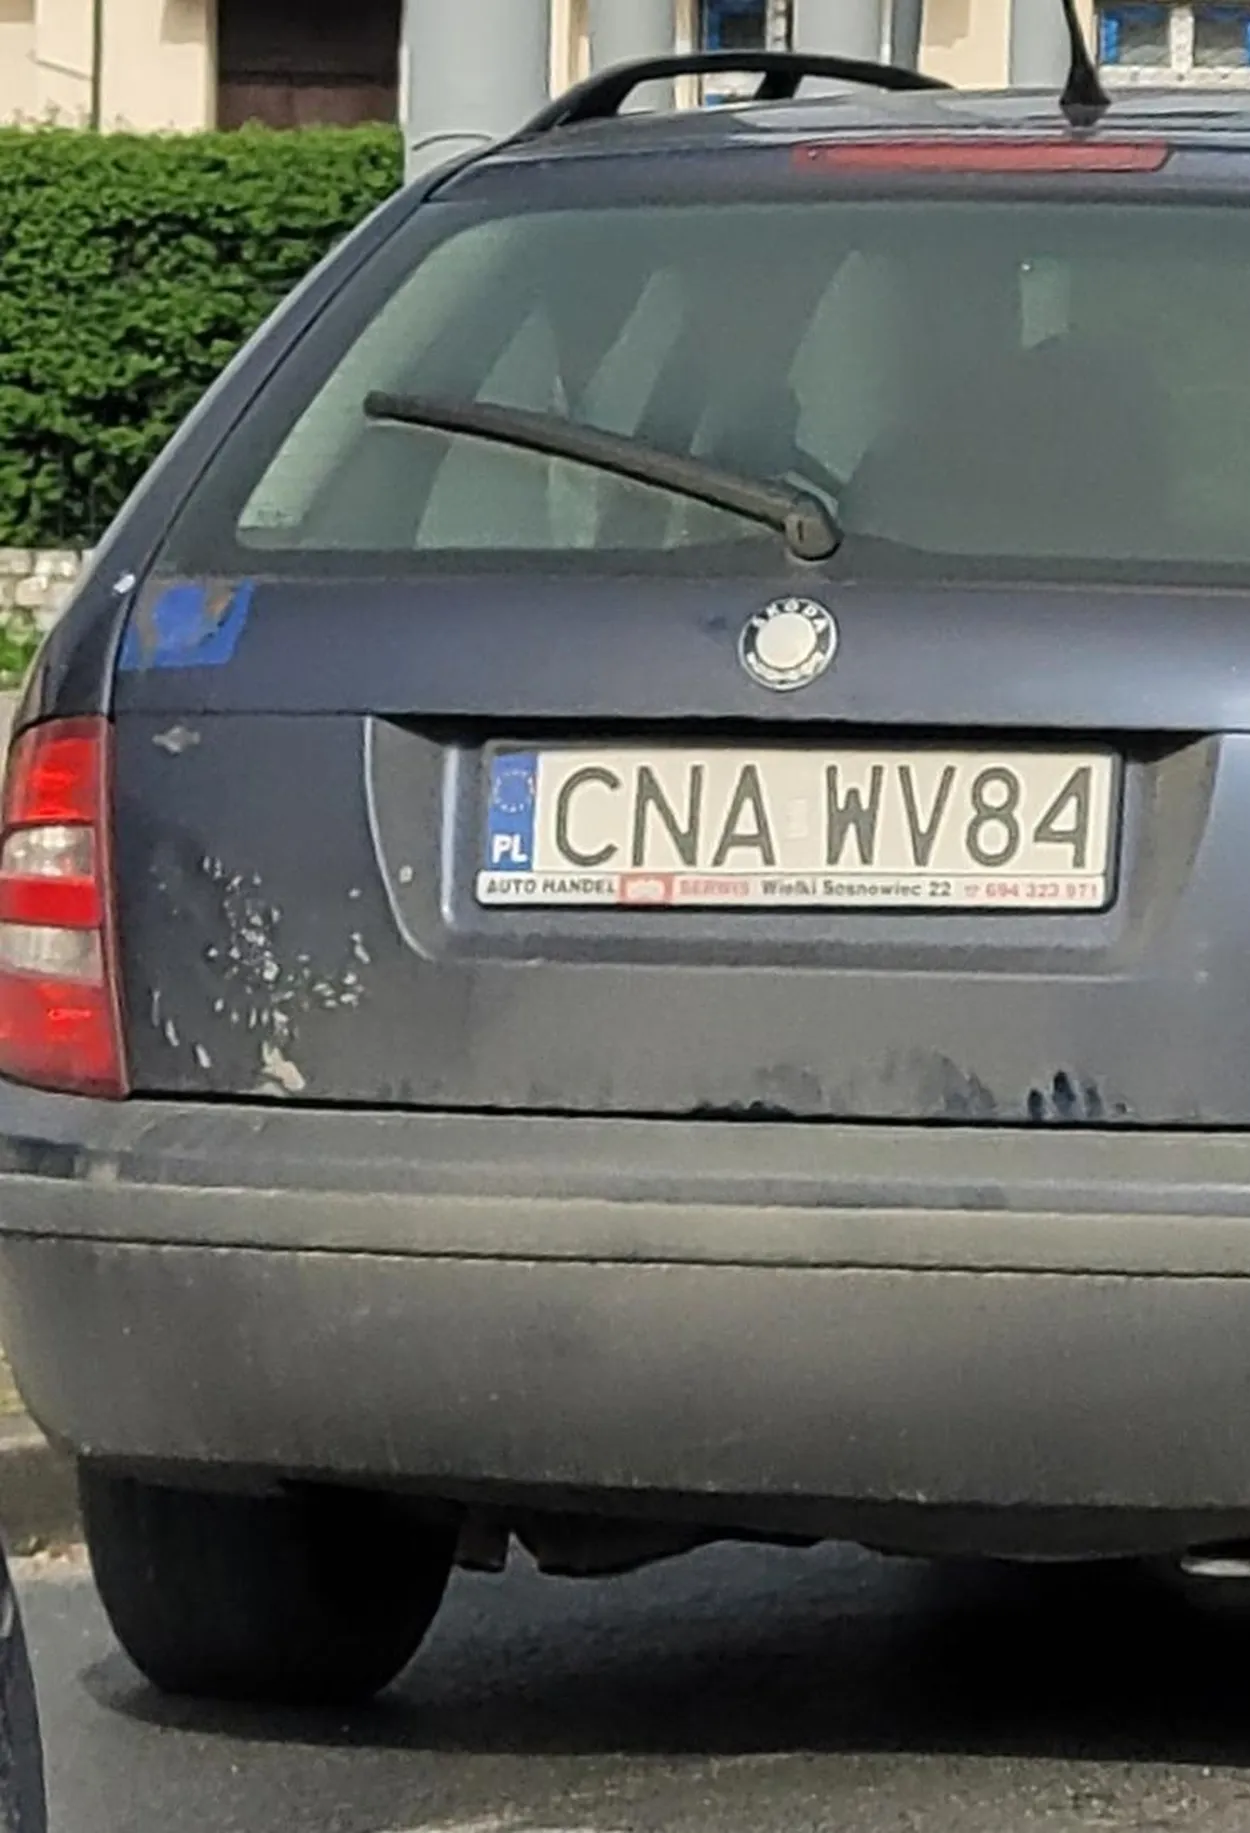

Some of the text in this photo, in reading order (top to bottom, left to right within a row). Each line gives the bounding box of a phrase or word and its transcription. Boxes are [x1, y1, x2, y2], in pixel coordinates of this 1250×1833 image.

[555, 764, 1094, 868] CNA WV84
[492, 834, 529, 864] PL
[487, 878, 537, 894] AUTO
[542, 879, 615, 894] HANDEL
[929, 881, 952, 896] 22
